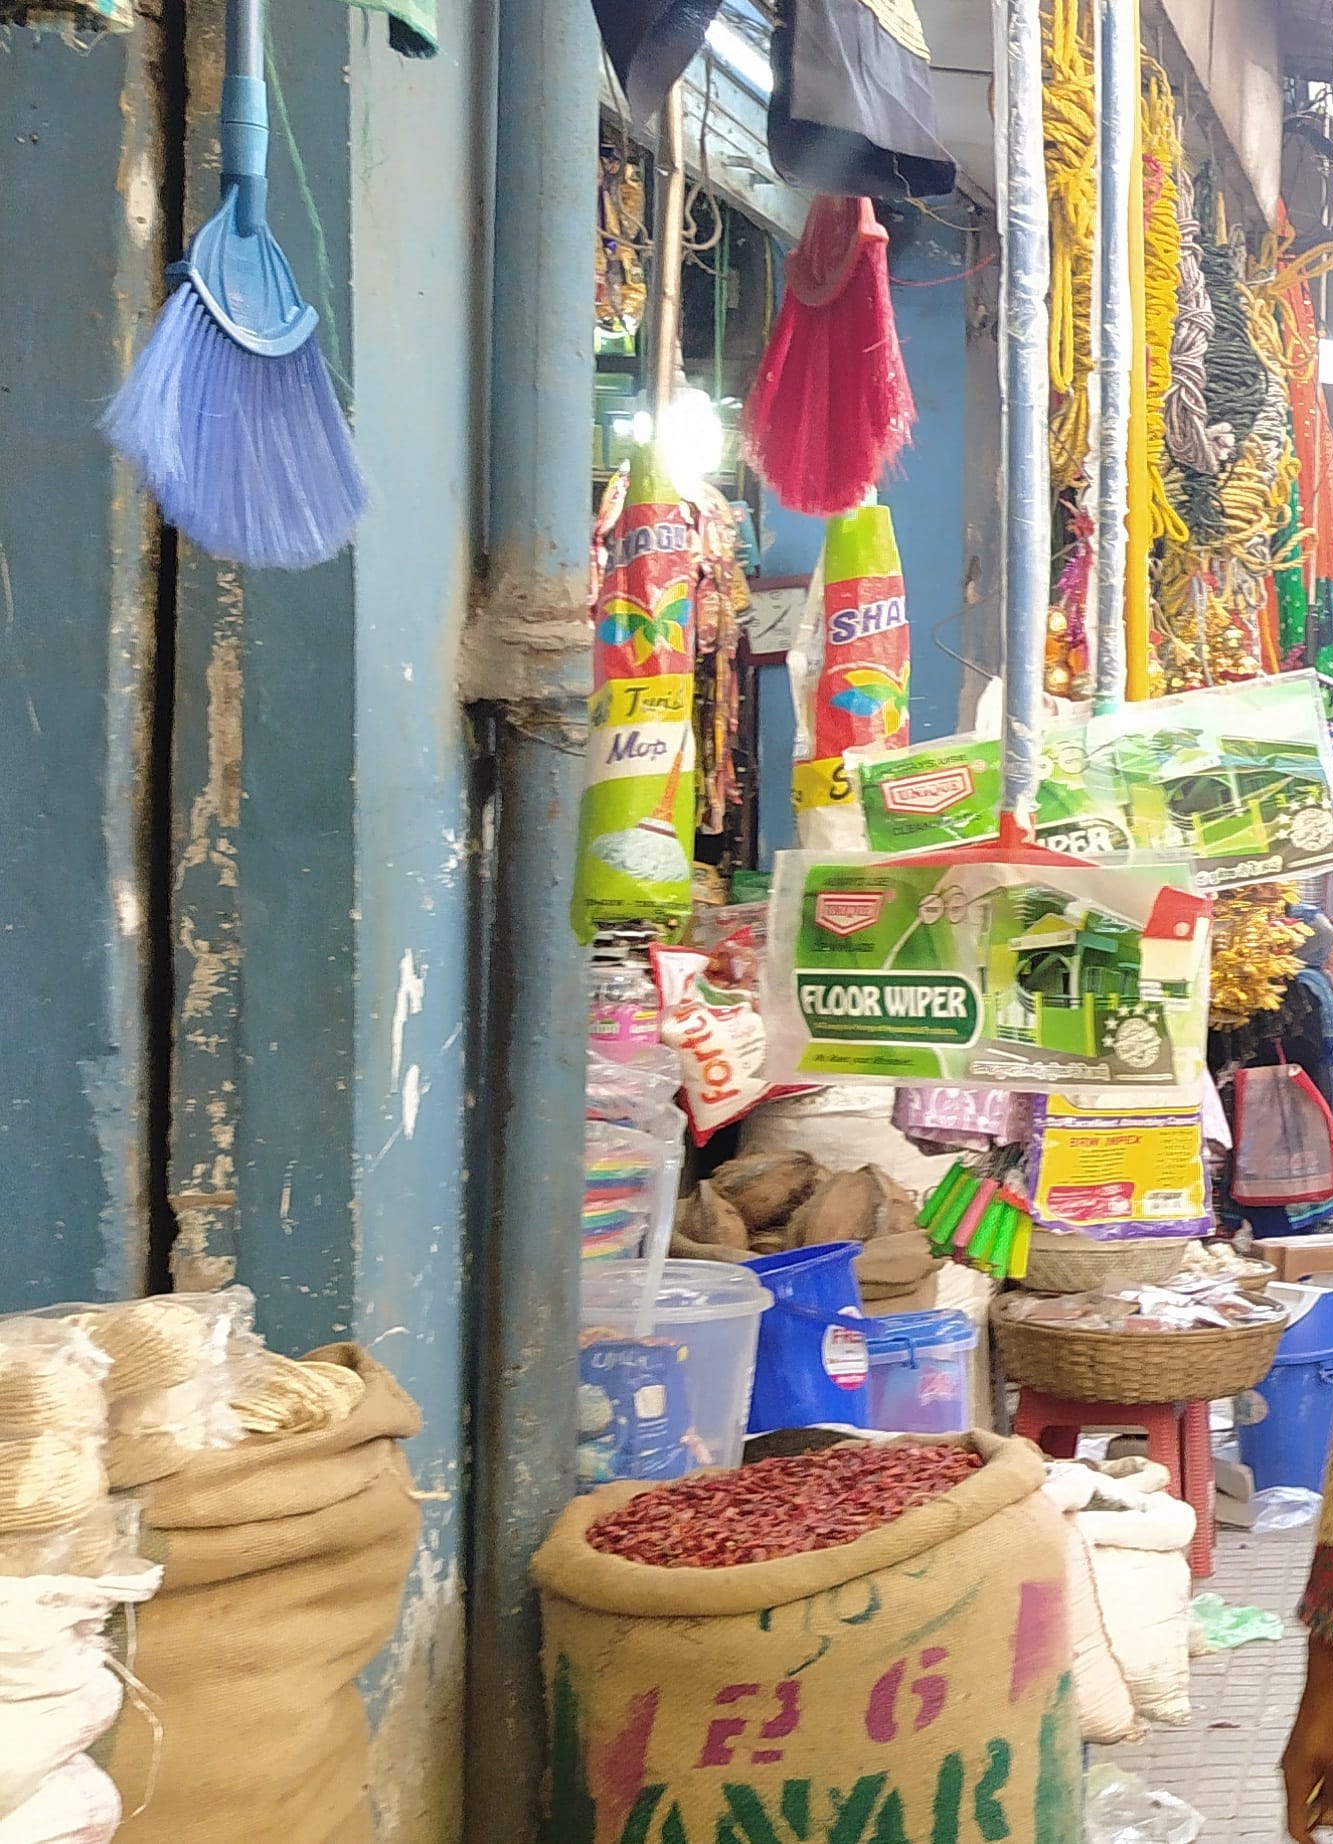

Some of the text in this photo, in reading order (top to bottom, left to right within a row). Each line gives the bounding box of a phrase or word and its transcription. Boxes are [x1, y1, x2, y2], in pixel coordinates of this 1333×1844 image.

[606, 731, 668, 765] Mop
[800, 984, 968, 1018] FLOOR WIPER
